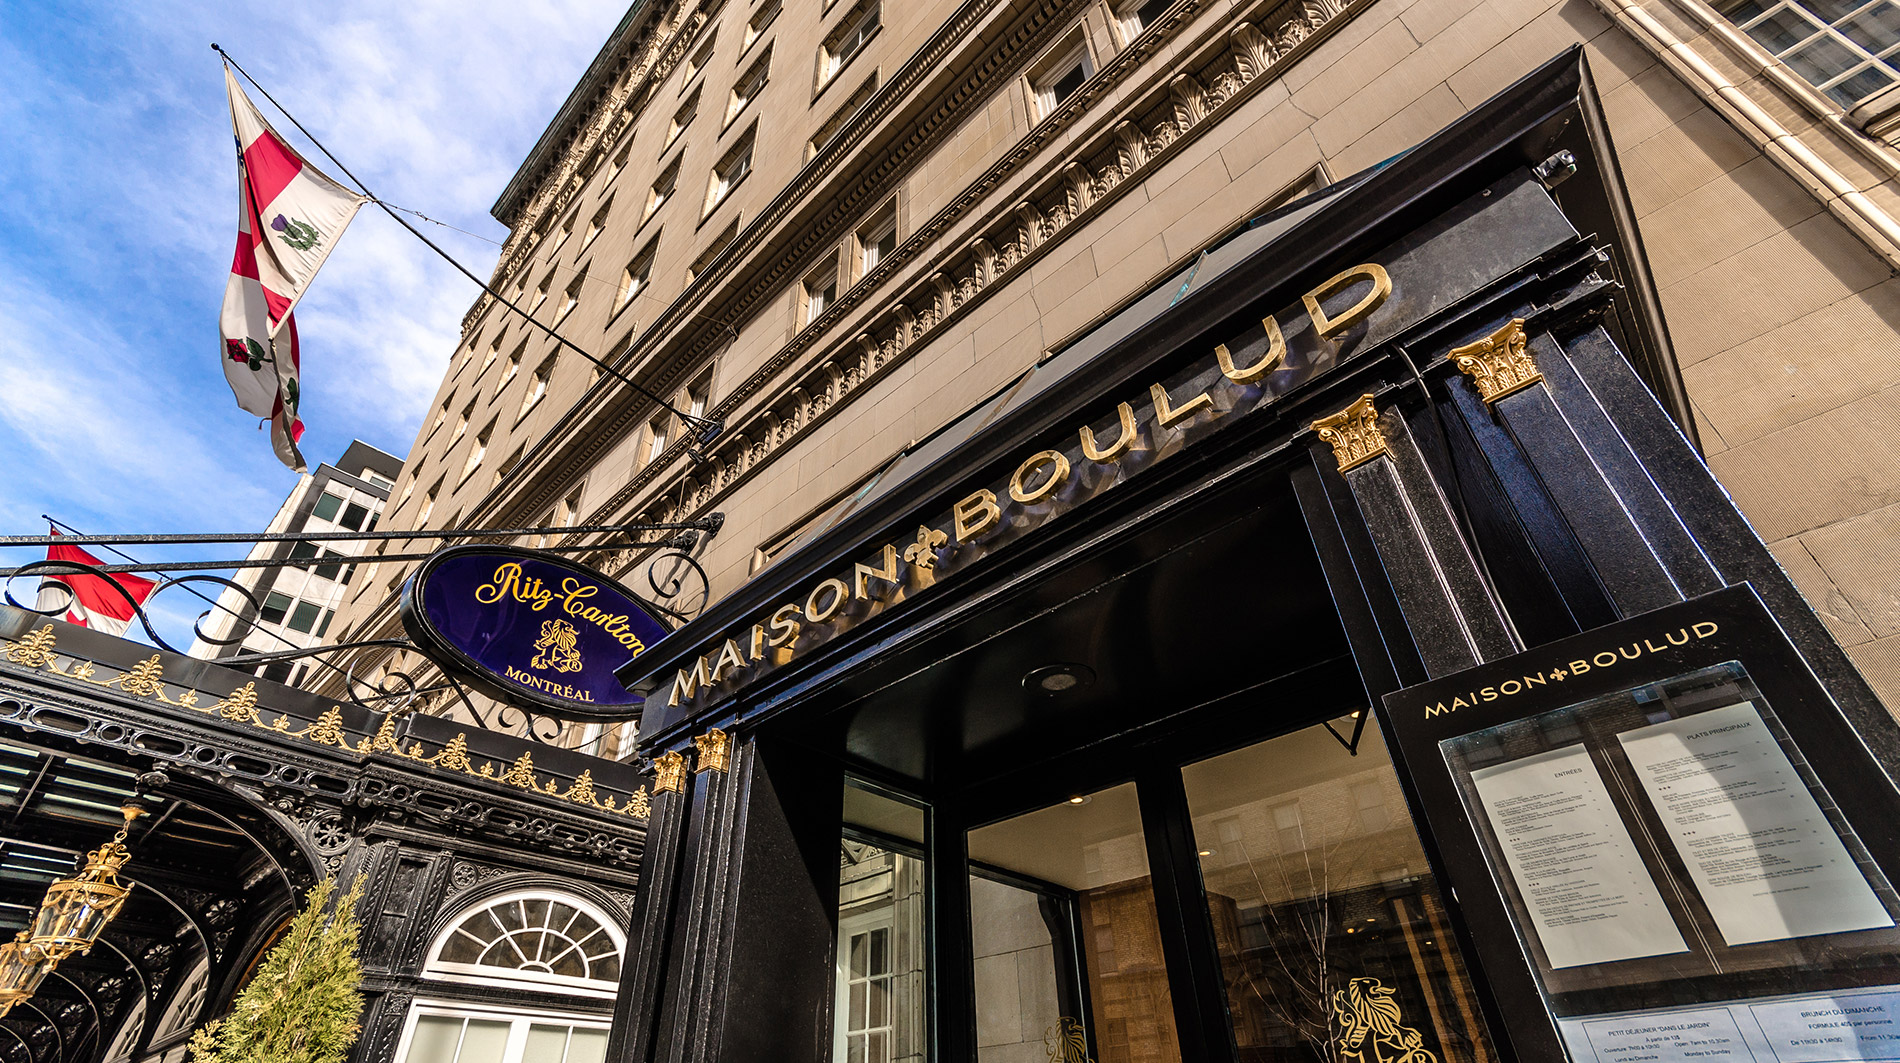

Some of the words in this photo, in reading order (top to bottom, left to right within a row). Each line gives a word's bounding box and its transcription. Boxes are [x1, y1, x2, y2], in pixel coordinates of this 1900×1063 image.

[668, 543, 898, 707] MAISON
[953, 262, 1393, 544] BOULUD
[475, 562, 646, 659] Ritz-Carlton
[504, 665, 595, 702] MONTRÉAL
[1425, 671, 1547, 720] MAISON
[1568, 621, 1719, 676] BOULUD
[1686, 731, 1709, 741] PLATS
[1708, 721, 1752, 737] PRINCIPAUX
[1554, 767, 1583, 779] ENTRÉES
[1800, 1009, 1831, 1018] BRUNCH
[1832, 1008, 1844, 1016] DU
[1844, 1005, 1885, 1015] DIMANCHE
[1808, 1021, 1840, 1030] FORMULE
